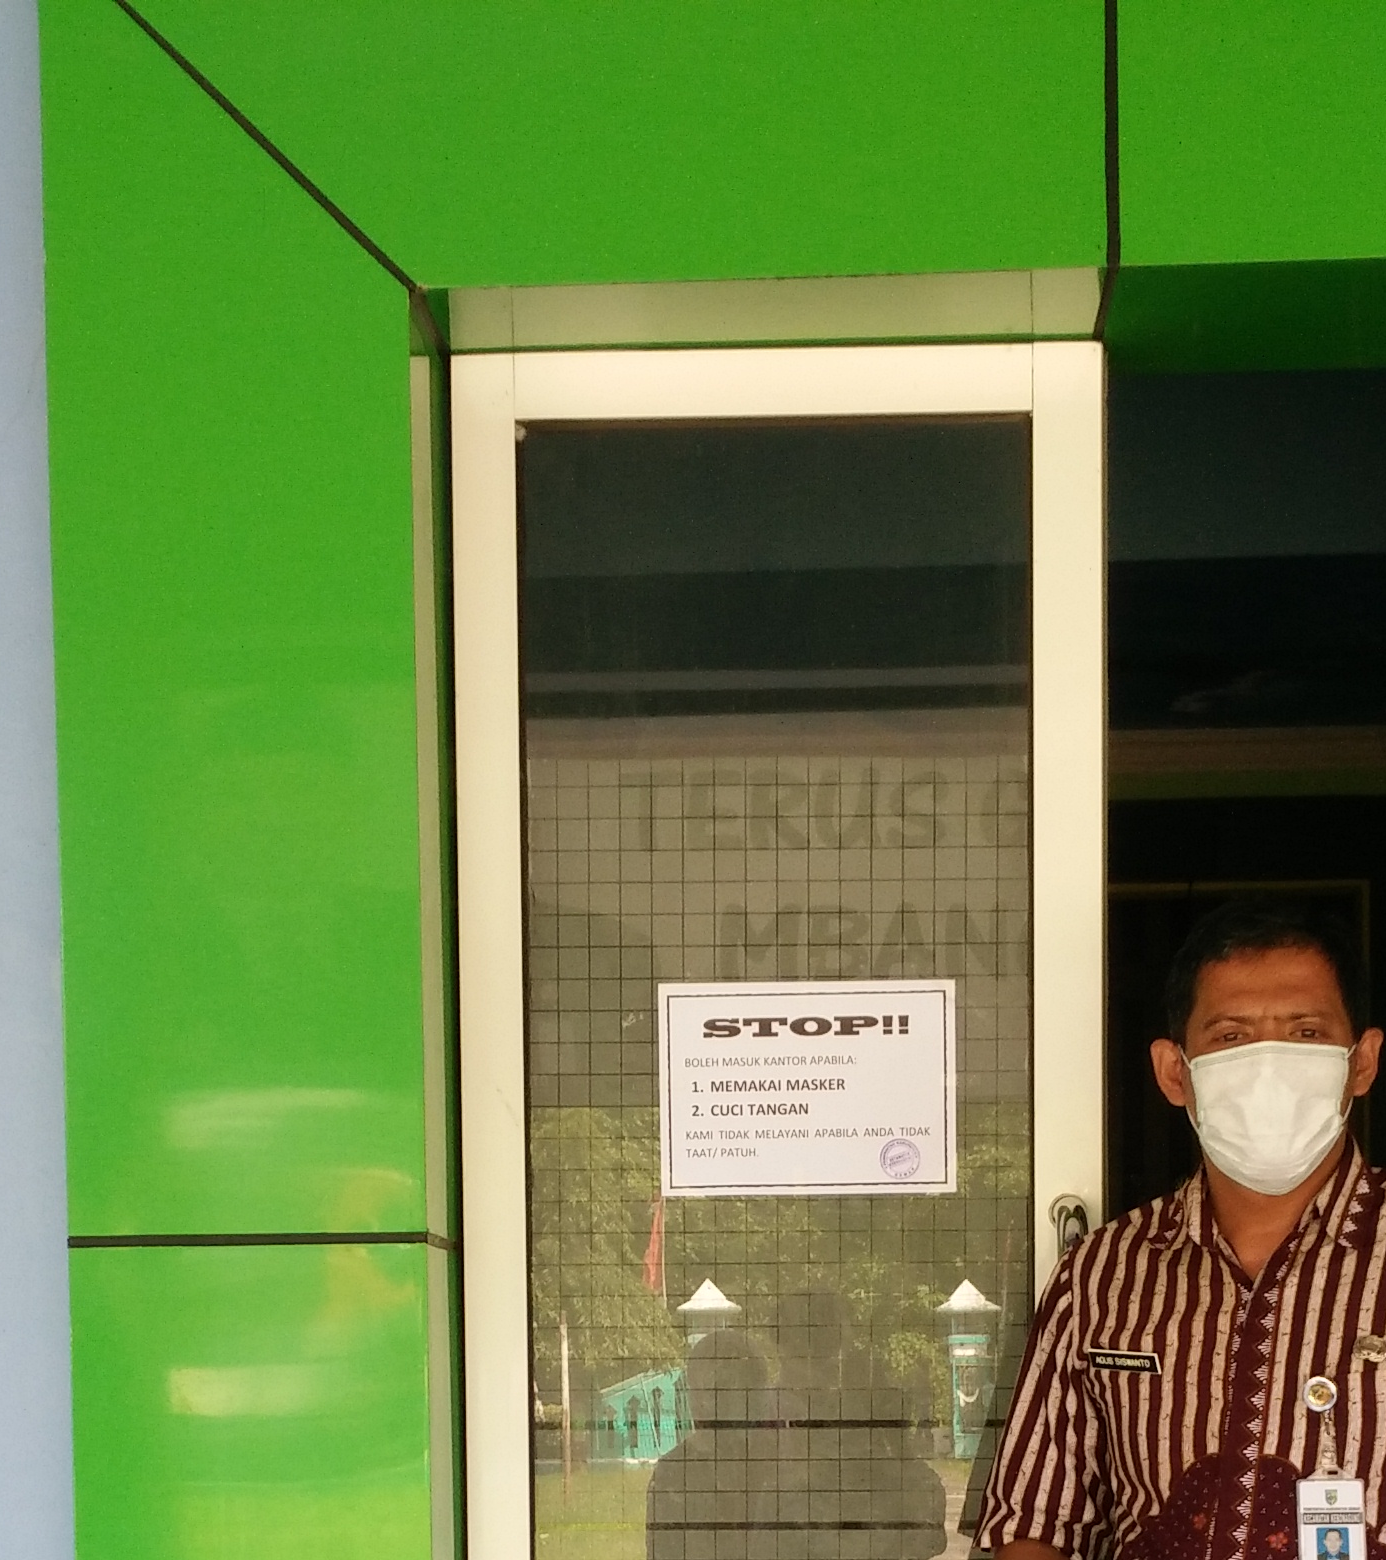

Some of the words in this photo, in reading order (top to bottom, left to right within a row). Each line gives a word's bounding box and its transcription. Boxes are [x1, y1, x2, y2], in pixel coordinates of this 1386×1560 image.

[719, 902, 1028, 980] MBAN
[703, 1015, 909, 1038] STOP!!
[685, 1057, 719, 1068] BOLEH
[722, 1056, 761, 1067] MASUK
[764, 1056, 807, 1066] KANTOR
[810, 1055, 857, 1066] APABILA:
[692, 1081, 704, 1093] 1.
[710, 1079, 782, 1092] MEMAKAI
[786, 1078, 846, 1091] MASKER
[692, 1105, 704, 1117] 2.
[710, 1104, 743, 1116] CUCI
[748, 1103, 808, 1116] TANGAN
[686, 1130, 713, 1140] KAMI
[719, 1129, 750, 1140] TIDAK
[755, 1129, 809, 1139] MELAYANI
[814, 1128, 859, 1138] APABILA
[863, 1127, 894, 1137] ANDA
[899, 1126, 930, 1137] TIDAK
[686, 1148, 717, 1158] TAAT/
[721, 1147, 759, 1158] PATUH.
